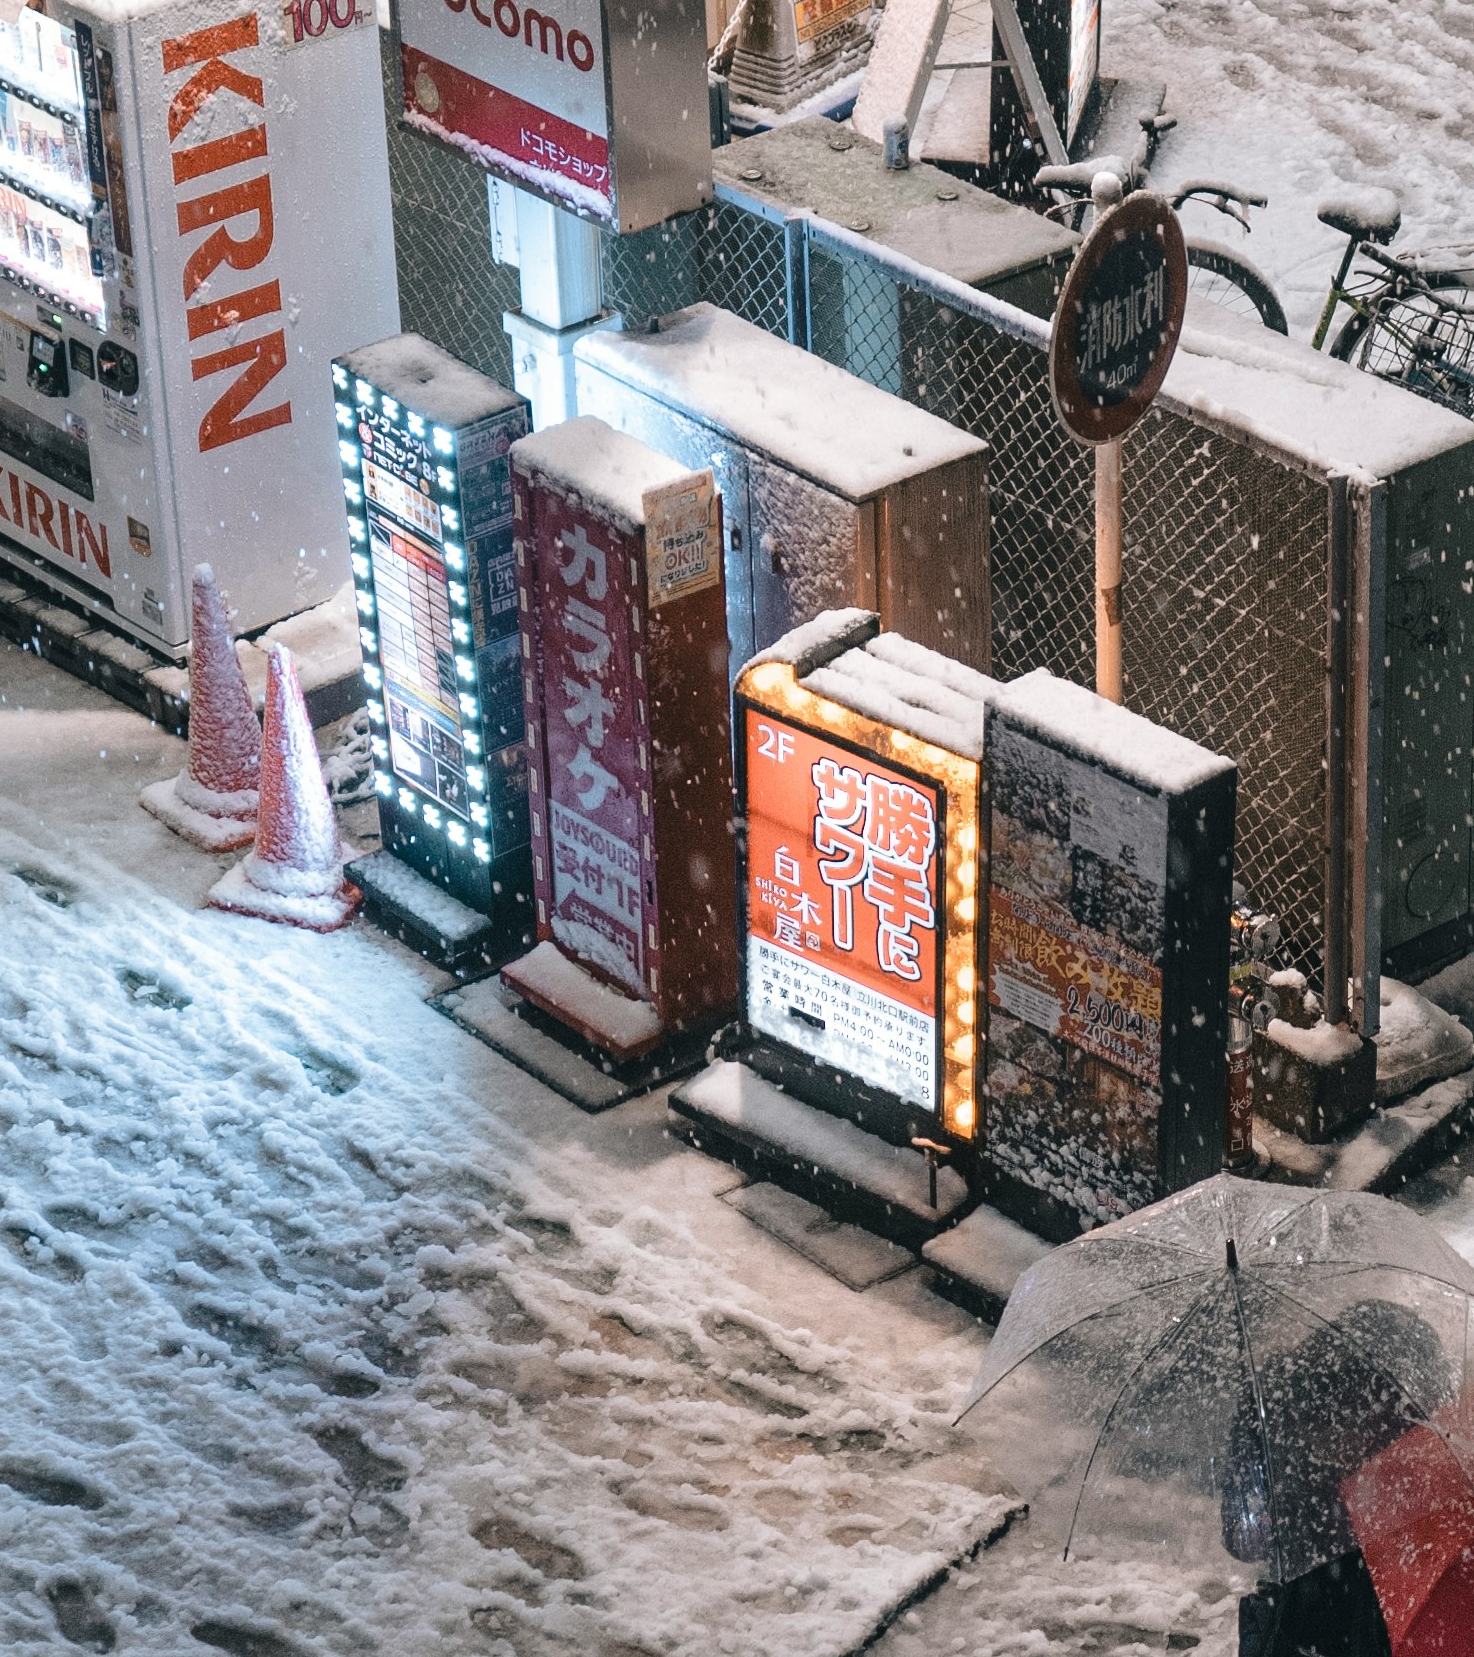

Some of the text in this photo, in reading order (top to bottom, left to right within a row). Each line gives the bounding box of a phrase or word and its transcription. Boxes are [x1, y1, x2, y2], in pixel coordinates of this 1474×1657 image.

[520, 128, 606, 183] ドコモショップ
[161, 13, 292, 451] KIRIN
[1077, 265, 1164, 374] 消防水利
[356, 405, 432, 459] インターネット
[373, 430, 417, 469] コミック
[422, 461, 438, 483] 8F
[559, 523, 620, 811] カラオケ
[758, 724, 795, 763] 2F
[554, 810, 639, 876] JOYSOUND
[812, 757, 867, 950] サワー
[755, 876, 787, 898] SHIRO
[761, 891, 787, 911] KIYA
[774, 845, 822, 952] 白木屋
[864, 773, 935, 981] 勝手に
[857, 990, 929, 1034] 立川北口駅前店
